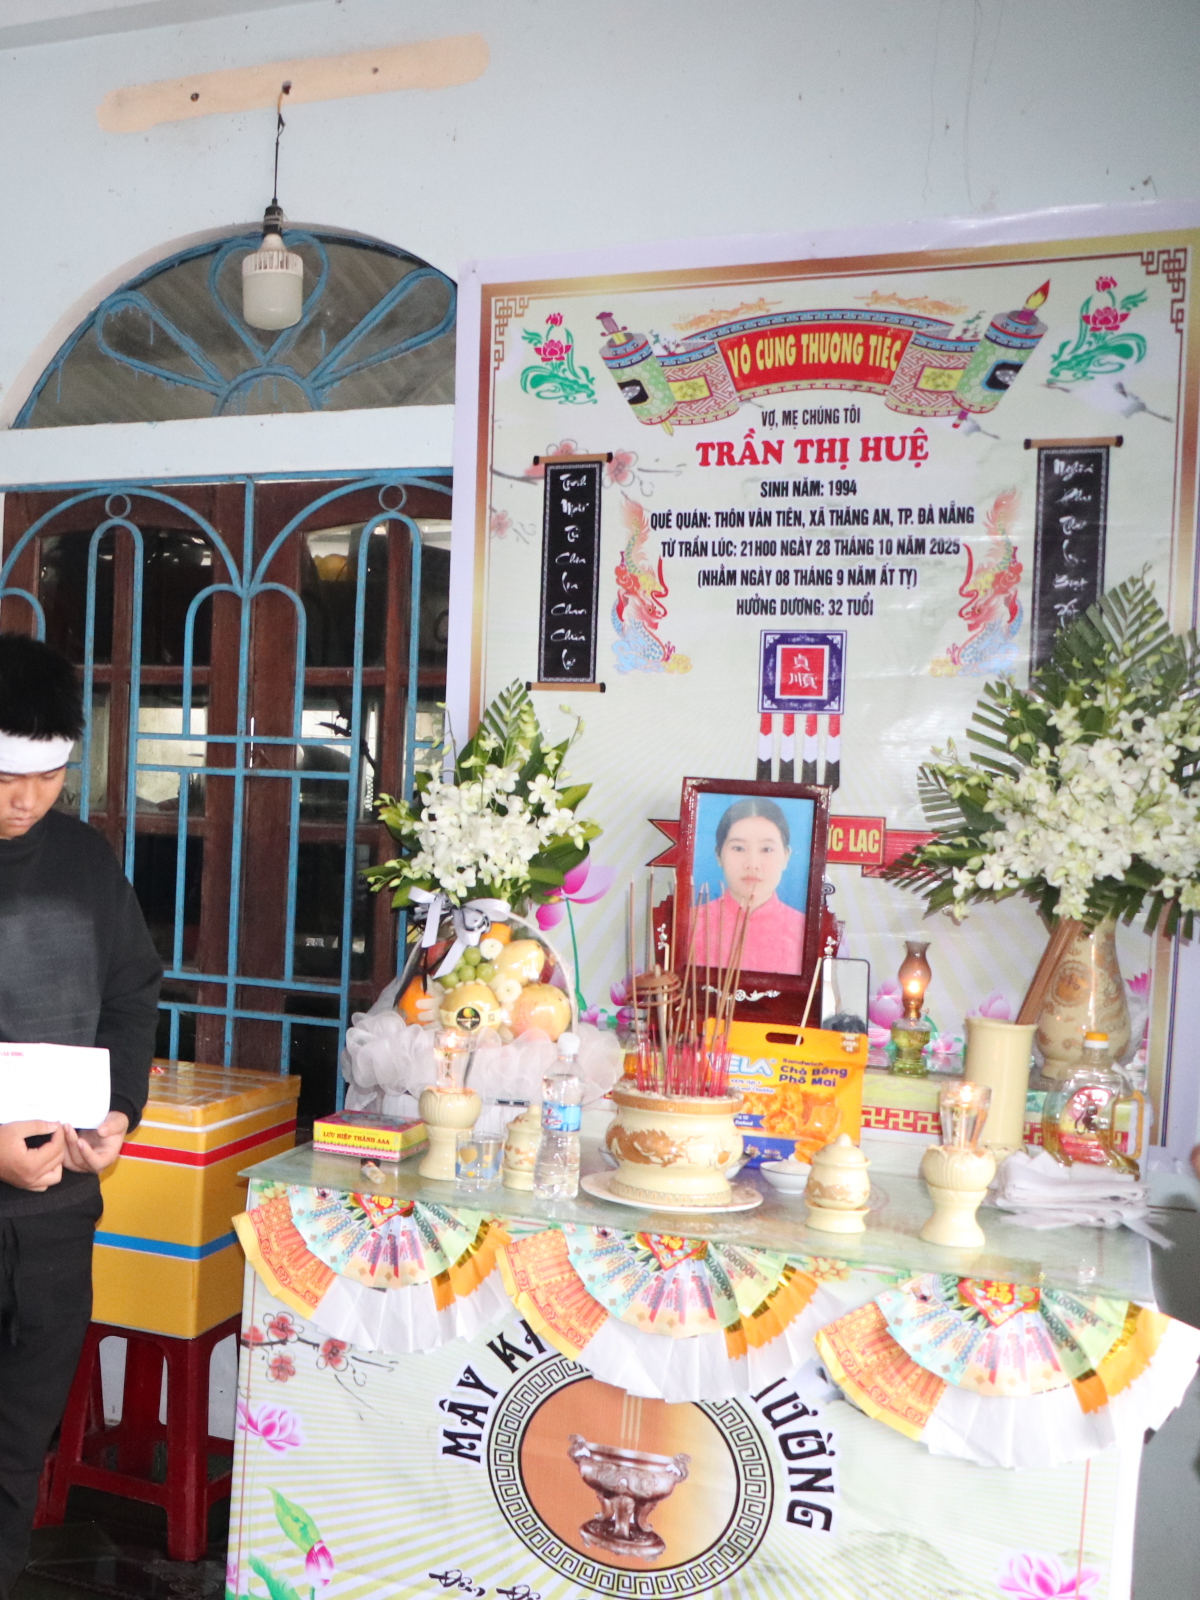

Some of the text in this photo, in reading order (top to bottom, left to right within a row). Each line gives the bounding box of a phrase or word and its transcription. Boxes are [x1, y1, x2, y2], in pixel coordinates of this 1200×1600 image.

[727, 329, 902, 379] VÔ CÙNG THƯƠNG TIẾC
[761, 404, 861, 430] VỢ, MẸ CHÚNG TÔI
[695, 427, 929, 470] TRẦN THỊ HUỆ
[760, 477, 857, 498] SINH NĂM: 1994
[650, 500, 975, 531] QUÊ QUÁN: THÔN VÂN TIÊN, XÃ THĂNG AN, TP. ĐÀ NẴNG
[661, 537, 676, 557] TỪ
[711, 537, 737, 557] LÚC:
[740, 540, 777, 557] 21H00
[780, 536, 813, 556] NGÀY
[816, 539, 831, 556] 28
[834, 535, 874, 556] THÁNG
[879, 539, 893, 555] 10
[896, 535, 926, 555] NĂM
[929, 538, 961, 555] 2025
[740, 566, 772, 586] NGÀY
[775, 570, 790, 586] 08
[793, 566, 833, 586] THÁNG
[836, 569, 844, 586] 9
[847, 565, 876, 586] NĂM
[879, 563, 895, 586] ẤT
[898, 568, 918, 590] TỴ)
[736, 592, 874, 616] HƯỞNG DƯƠNG: 32 TUỔI
[849, 828, 880, 857] LẠC
[782, 1058, 824, 1067] Sandwich
[811, 1066, 848, 1078] Bông
[779, 1074, 837, 1087] Phô Mai
[439, 1365, 498, 1464] MÂY
